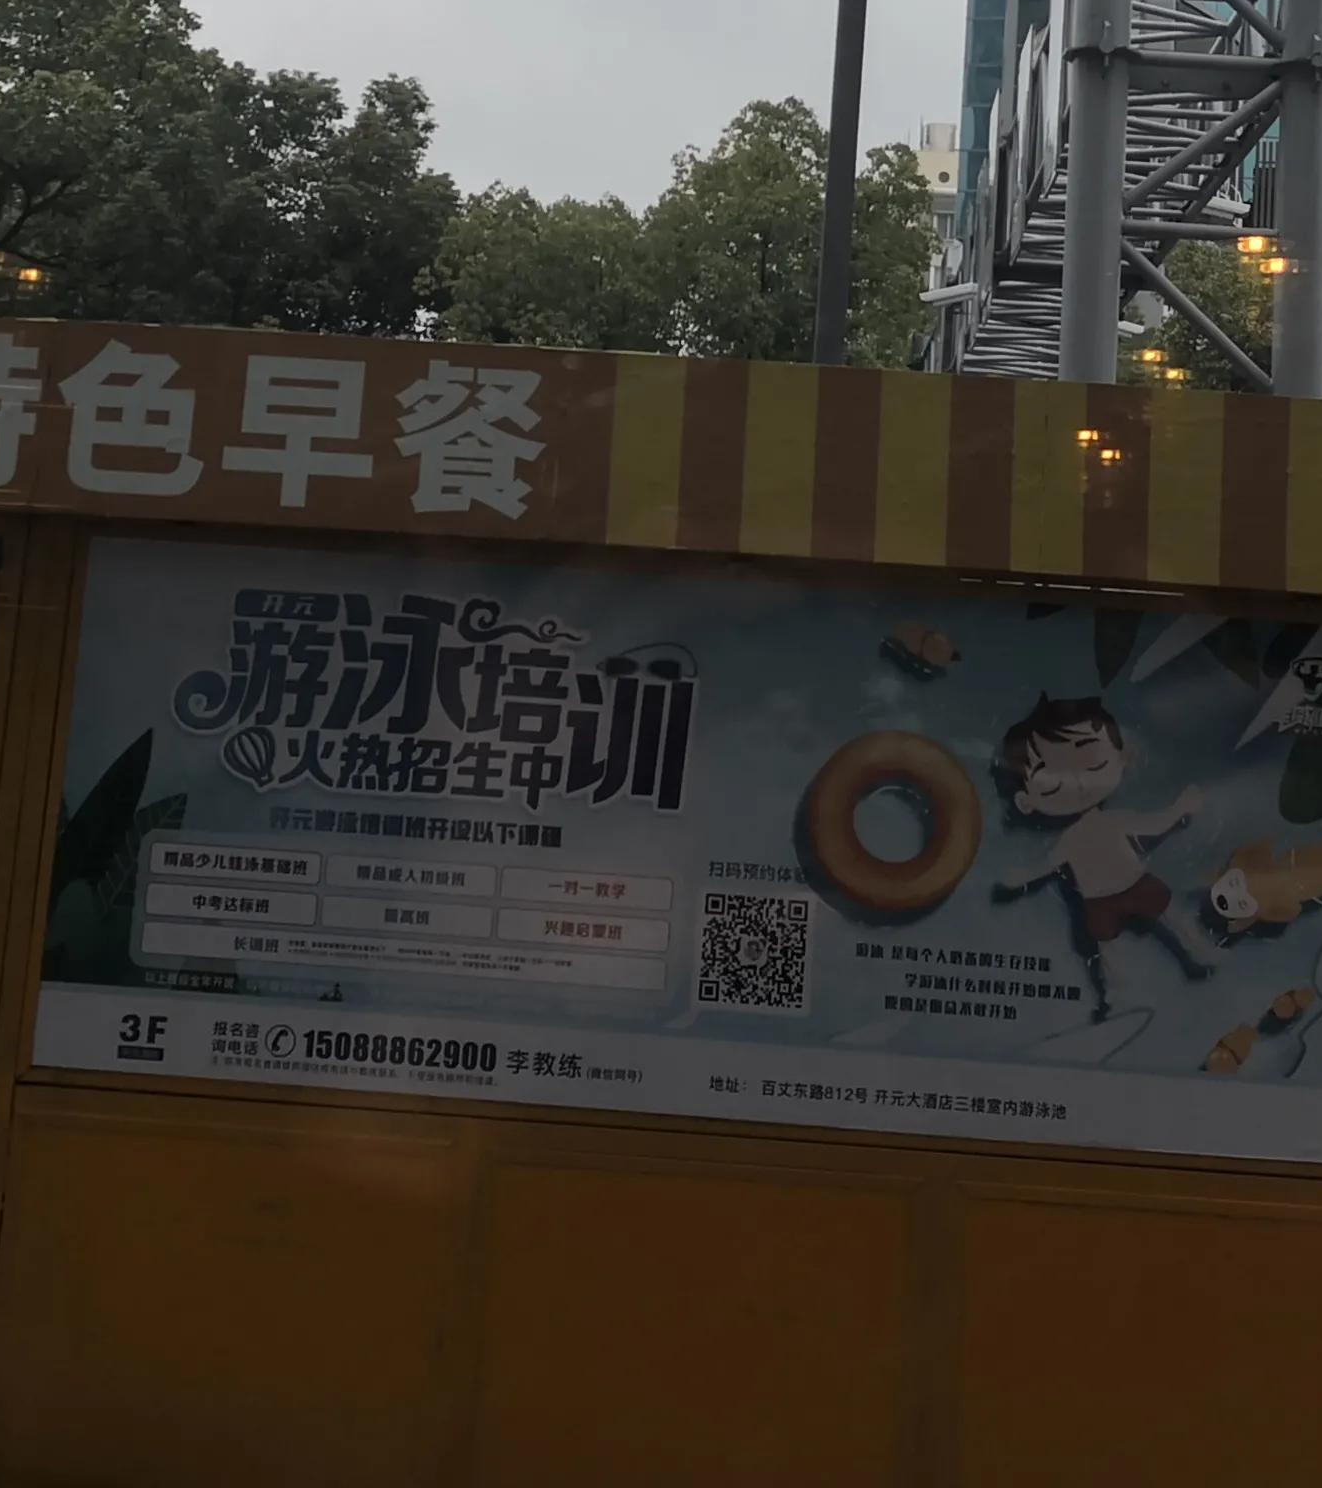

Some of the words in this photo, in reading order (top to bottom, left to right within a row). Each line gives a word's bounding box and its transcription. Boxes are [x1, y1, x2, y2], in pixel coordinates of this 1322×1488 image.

[262, 594, 315, 616] 开元
[175, 593, 694, 811] 游泳培训
[278, 728, 564, 810] 火热招生中
[548, 880, 627, 901] 一对一教学
[192, 894, 270, 914] 中考达标班
[119, 1014, 168, 1044] 3F
[213, 1021, 260, 1038] 报名咨
[212, 1038, 260, 1057] 询电话
[303, 1029, 497, 1073] 15088862900
[506, 1049, 583, 1079] 李教练
[760, 1079, 868, 1104] 百丈东路812号
